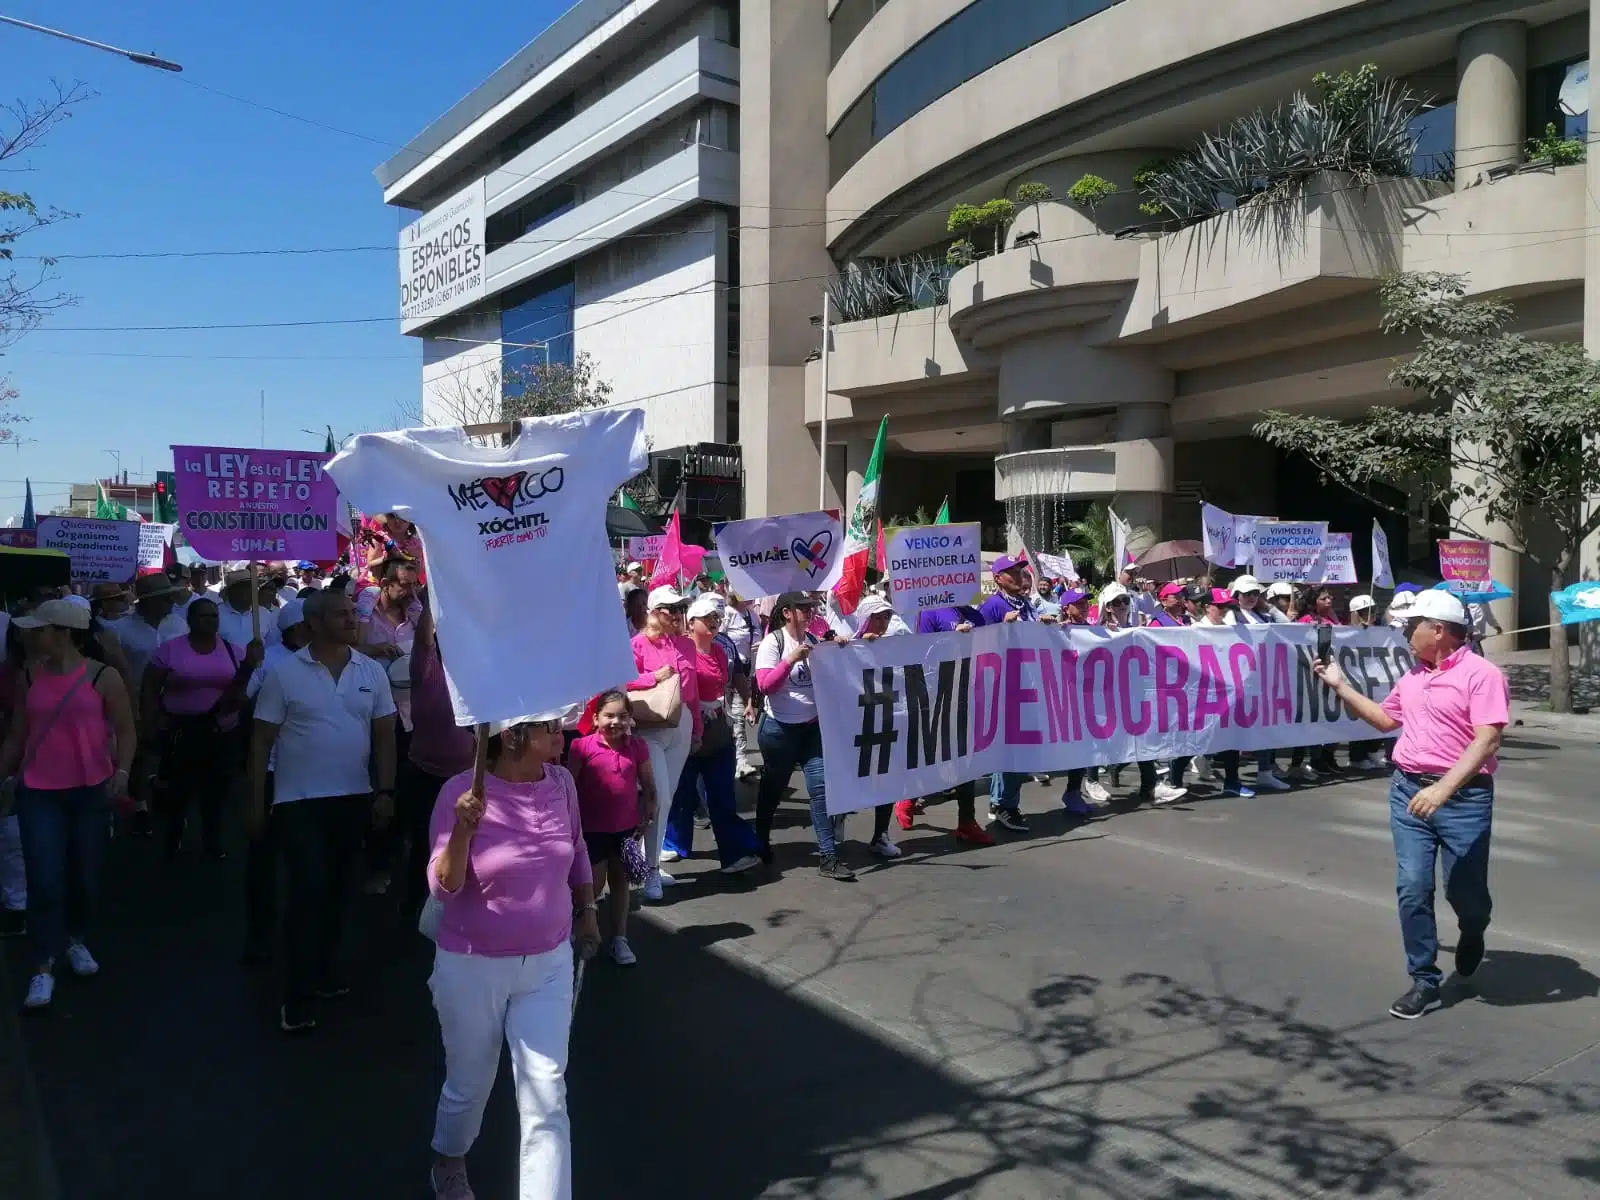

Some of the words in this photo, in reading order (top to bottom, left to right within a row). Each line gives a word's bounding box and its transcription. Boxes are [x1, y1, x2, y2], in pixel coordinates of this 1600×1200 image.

[412, 217, 471, 274] ESPACIOS
[401, 244, 481, 307] DISPONIBLES
[205, 453, 250, 479] LEY
[251, 465, 263, 475] es
[286, 459, 325, 481] LEY
[208, 480, 310, 500] RESPETO
[60, 520, 117, 531] Queremos
[186, 505, 328, 531] CONSTITUCIÓN
[477, 512, 550, 535] XÓCHITL
[56, 529, 120, 542] Organismos
[905, 536, 949, 550] VENGO
[953, 535, 962, 547] A
[1260, 536, 1322, 546] DEMOCRACIA
[46, 539, 129, 552] Independientes
[892, 554, 958, 571] DENFENDER
[961, 553, 976, 564] LA
[1262, 557, 1319, 567] DICTADURA
[894, 572, 976, 591] DEMOCRACIA
